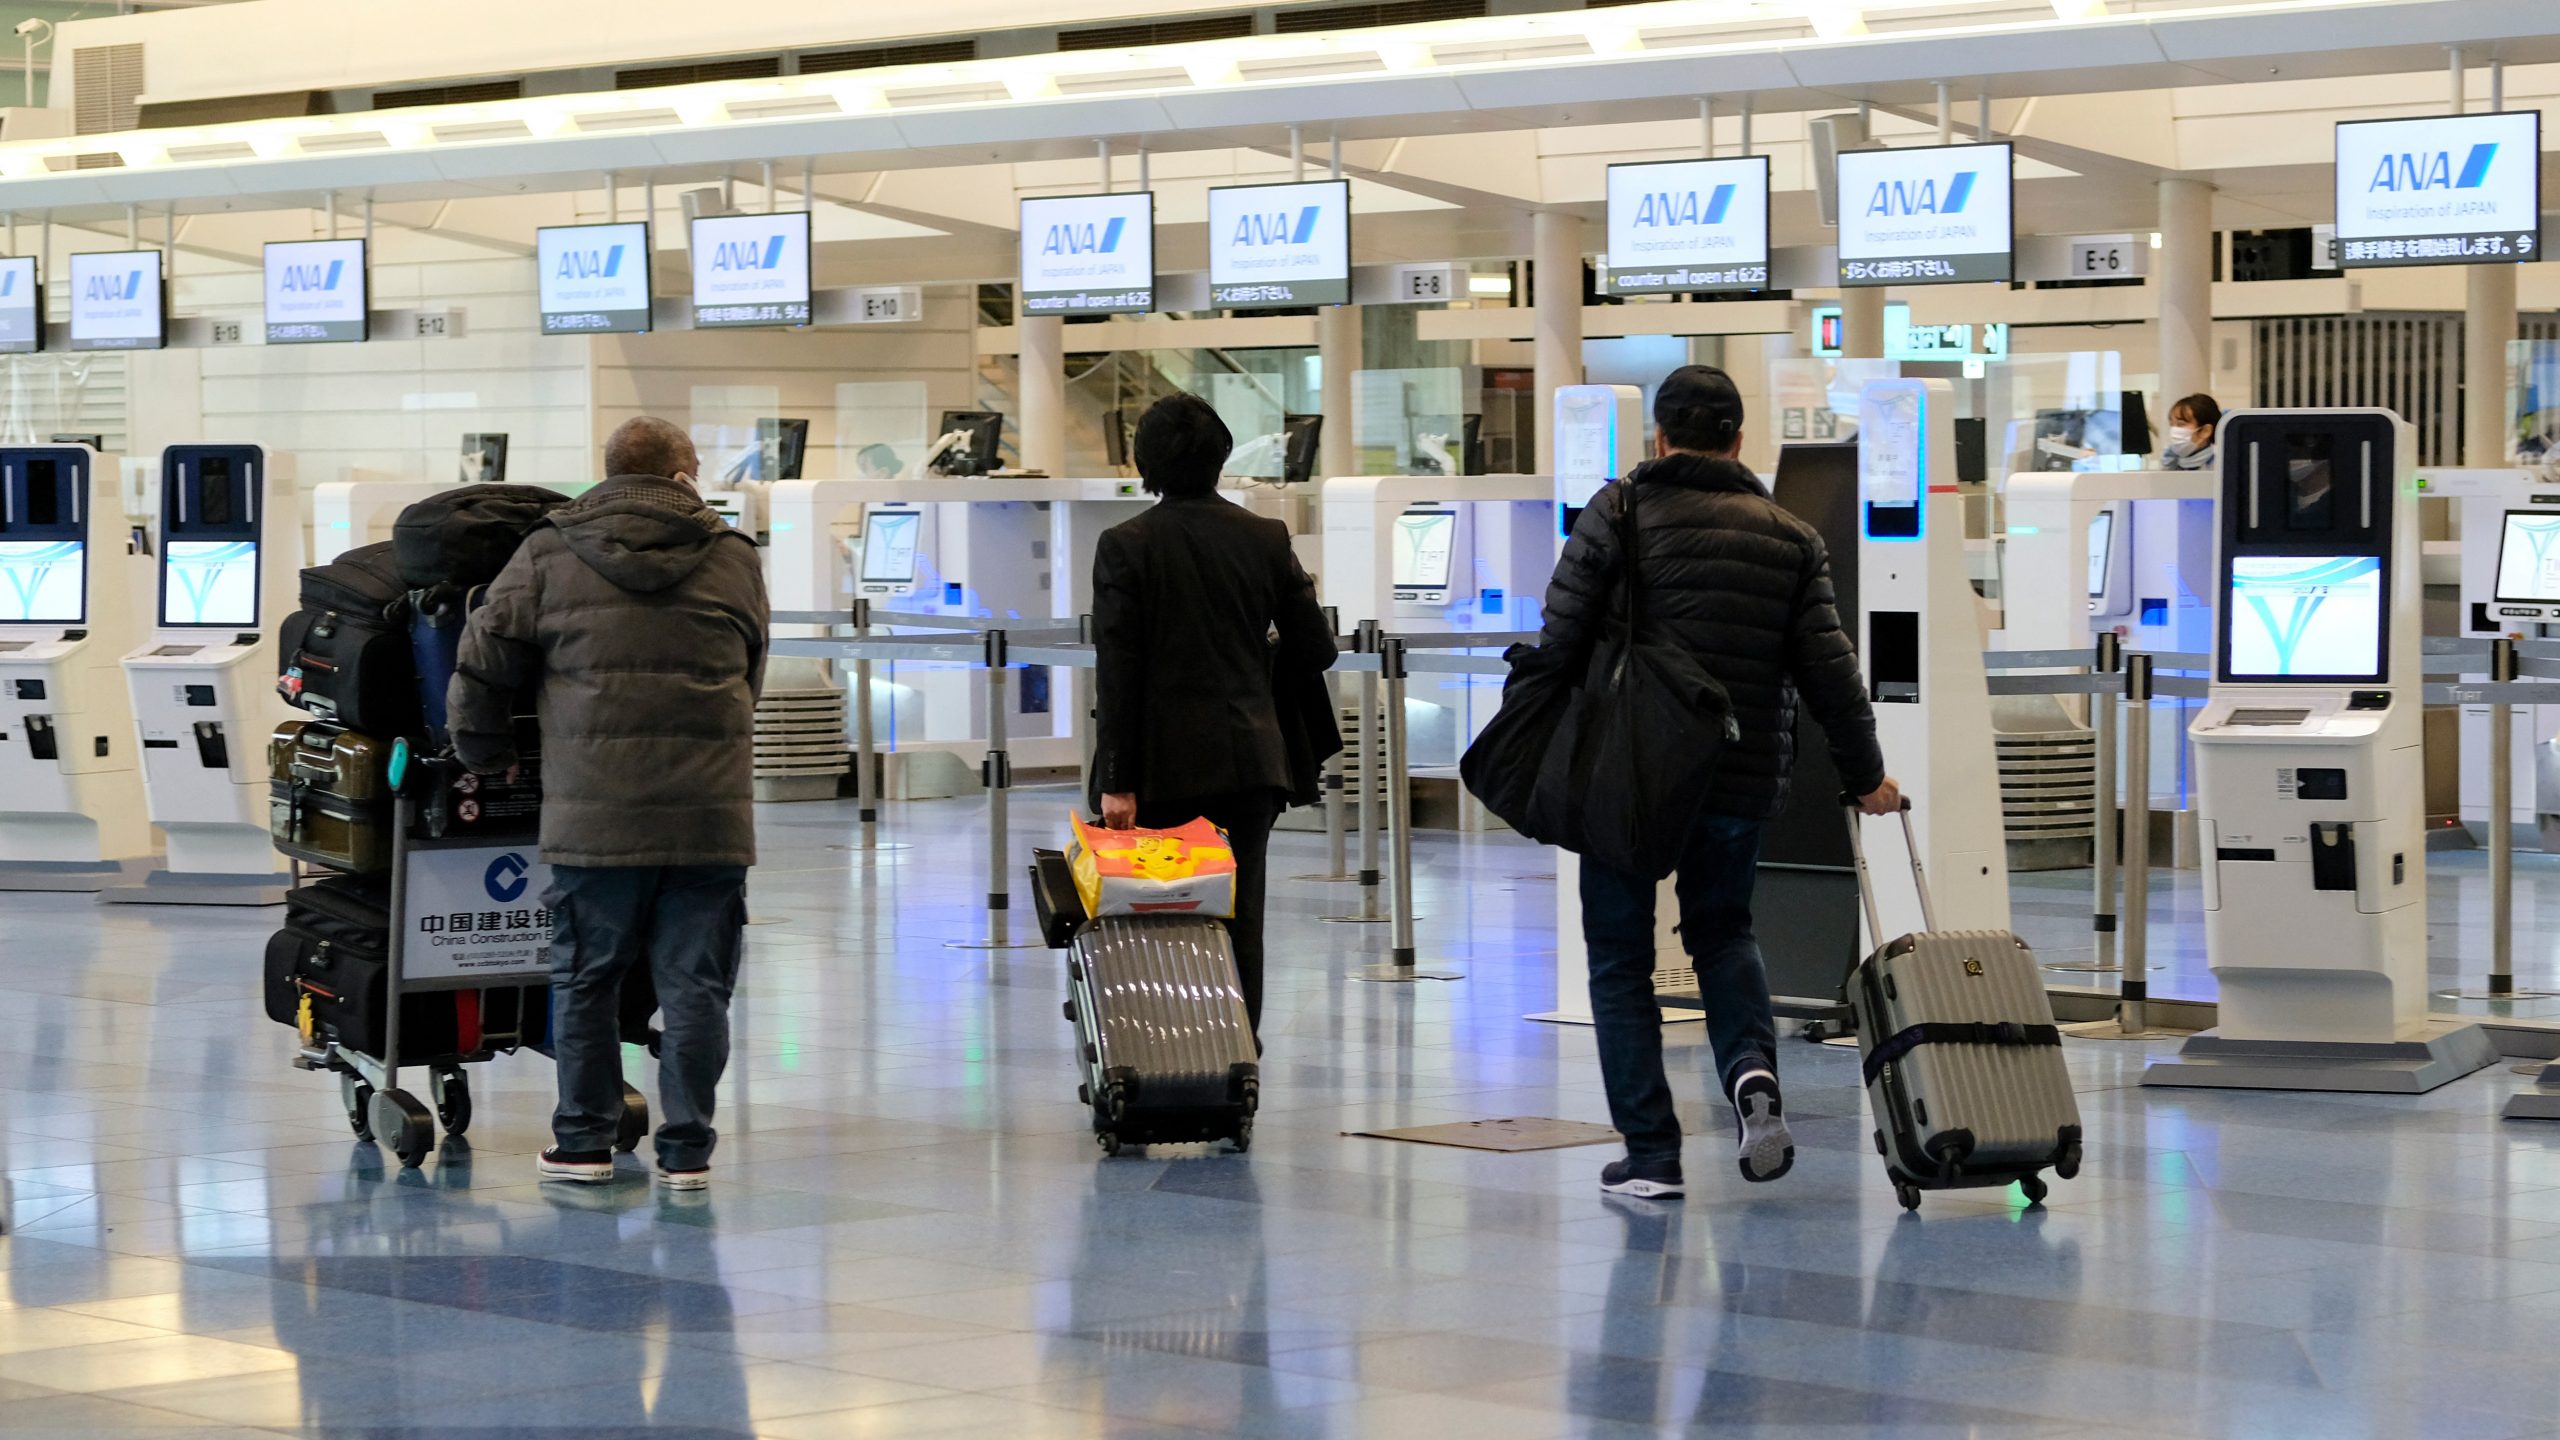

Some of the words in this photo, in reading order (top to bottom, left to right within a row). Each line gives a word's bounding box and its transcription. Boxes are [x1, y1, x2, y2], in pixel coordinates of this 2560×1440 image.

[2368, 151, 2450, 193] ANA
[1866, 179, 1936, 217] ANA
[1633, 191, 1698, 228] ANA
[2366, 205, 2434, 221] Inspiration
[2437, 202, 2453, 217] of
[2454, 201, 2497, 216] JAPAN
[1042, 223, 1096, 256] ANA
[1232, 212, 1288, 247] ANA
[1864, 229, 1921, 243] Inspiration
[1925, 226, 1937, 240] of
[1939, 225, 1977, 238] JAPAN
[1632, 239, 1685, 251] Inspiration
[1688, 236, 1699, 249] of
[1700, 236, 1735, 248] JAPAN
[556, 250, 601, 280] ANA
[711, 240, 760, 272] ANA
[2085, 249, 2120, 271] E-6
[280, 264, 322, 292] ANA
[1413, 275, 1440, 295] E-8
[1618, 272, 1664, 287] counter
[1665, 268, 1689, 285] will
[1689, 271, 1722, 285] open
[1723, 268, 1738, 282] at
[1739, 266, 1767, 282] 6:25
[866, 299, 898, 317] E-10
[1028, 297, 1067, 309] counter
[1068, 292, 1087, 308] will
[1087, 295, 1114, 308] open
[1114, 293, 1127, 306] at
[213, 325, 240, 342] E-13
[417, 317, 445, 335] E-12
[431, 934, 466, 947] China
[469, 930, 542, 945] Construction
